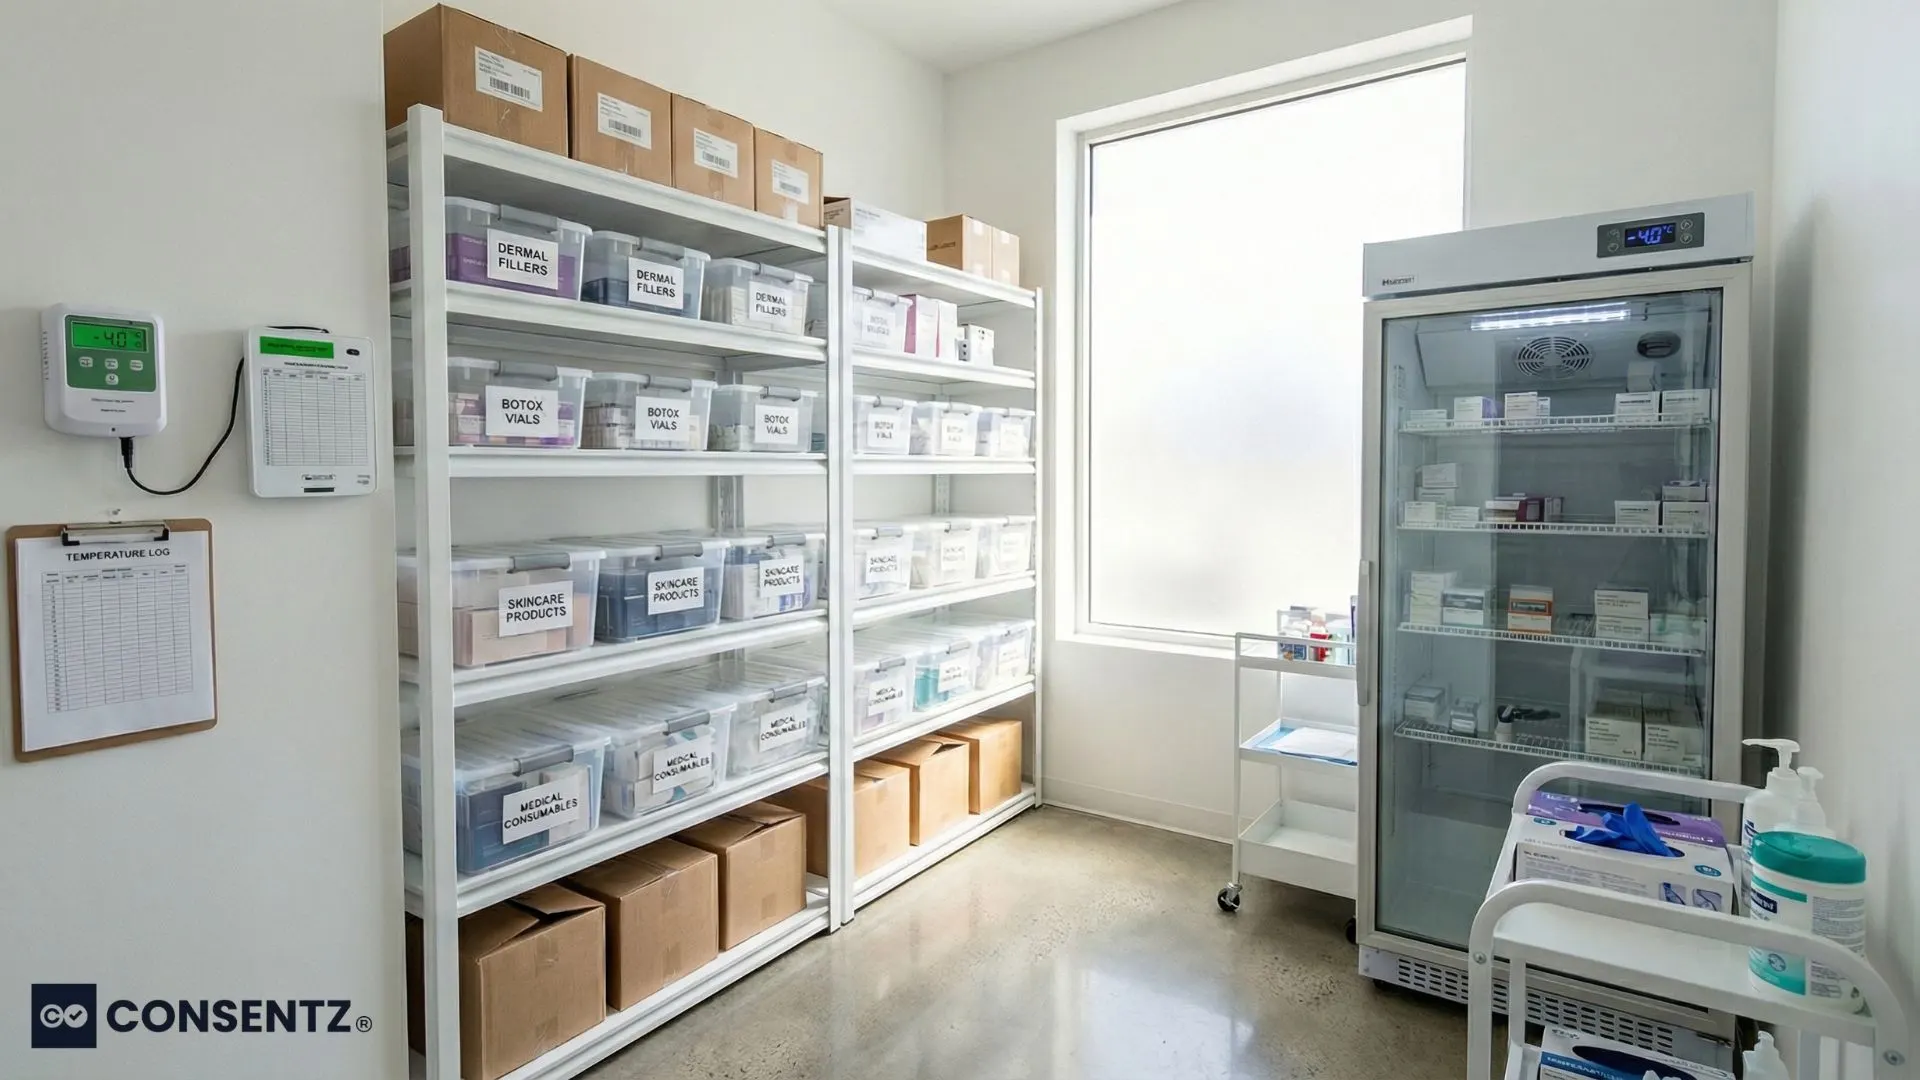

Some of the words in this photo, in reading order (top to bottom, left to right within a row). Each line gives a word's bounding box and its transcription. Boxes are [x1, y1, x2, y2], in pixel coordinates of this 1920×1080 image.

[498, 242, 549, 262] DERMAL
[498, 257, 548, 276] FILLERS
[637, 269, 676, 285] DERMAL
[637, 282, 676, 298] FILLERS
[755, 291, 787, 306] DERMAL
[502, 398, 543, 411] BOTOX
[505, 413, 540, 425] VIALS
[648, 407, 680, 418] BOTOX
[764, 414, 790, 424] BOTOX
[650, 420, 677, 431] VIALS
[766, 425, 788, 435] VIALS
[65, 549, 146, 561] TEMPERATURE
[148, 547, 170, 557] LOG
[655, 577, 698, 591] SKINCARE
[508, 593, 565, 610] SKINCARE
[653, 588, 699, 602] PRODUCTS
[506, 606, 567, 623] PRODUCTS
[520, 792, 563, 812] MEDICAL
[504, 798, 578, 829] CONSUMABLES
